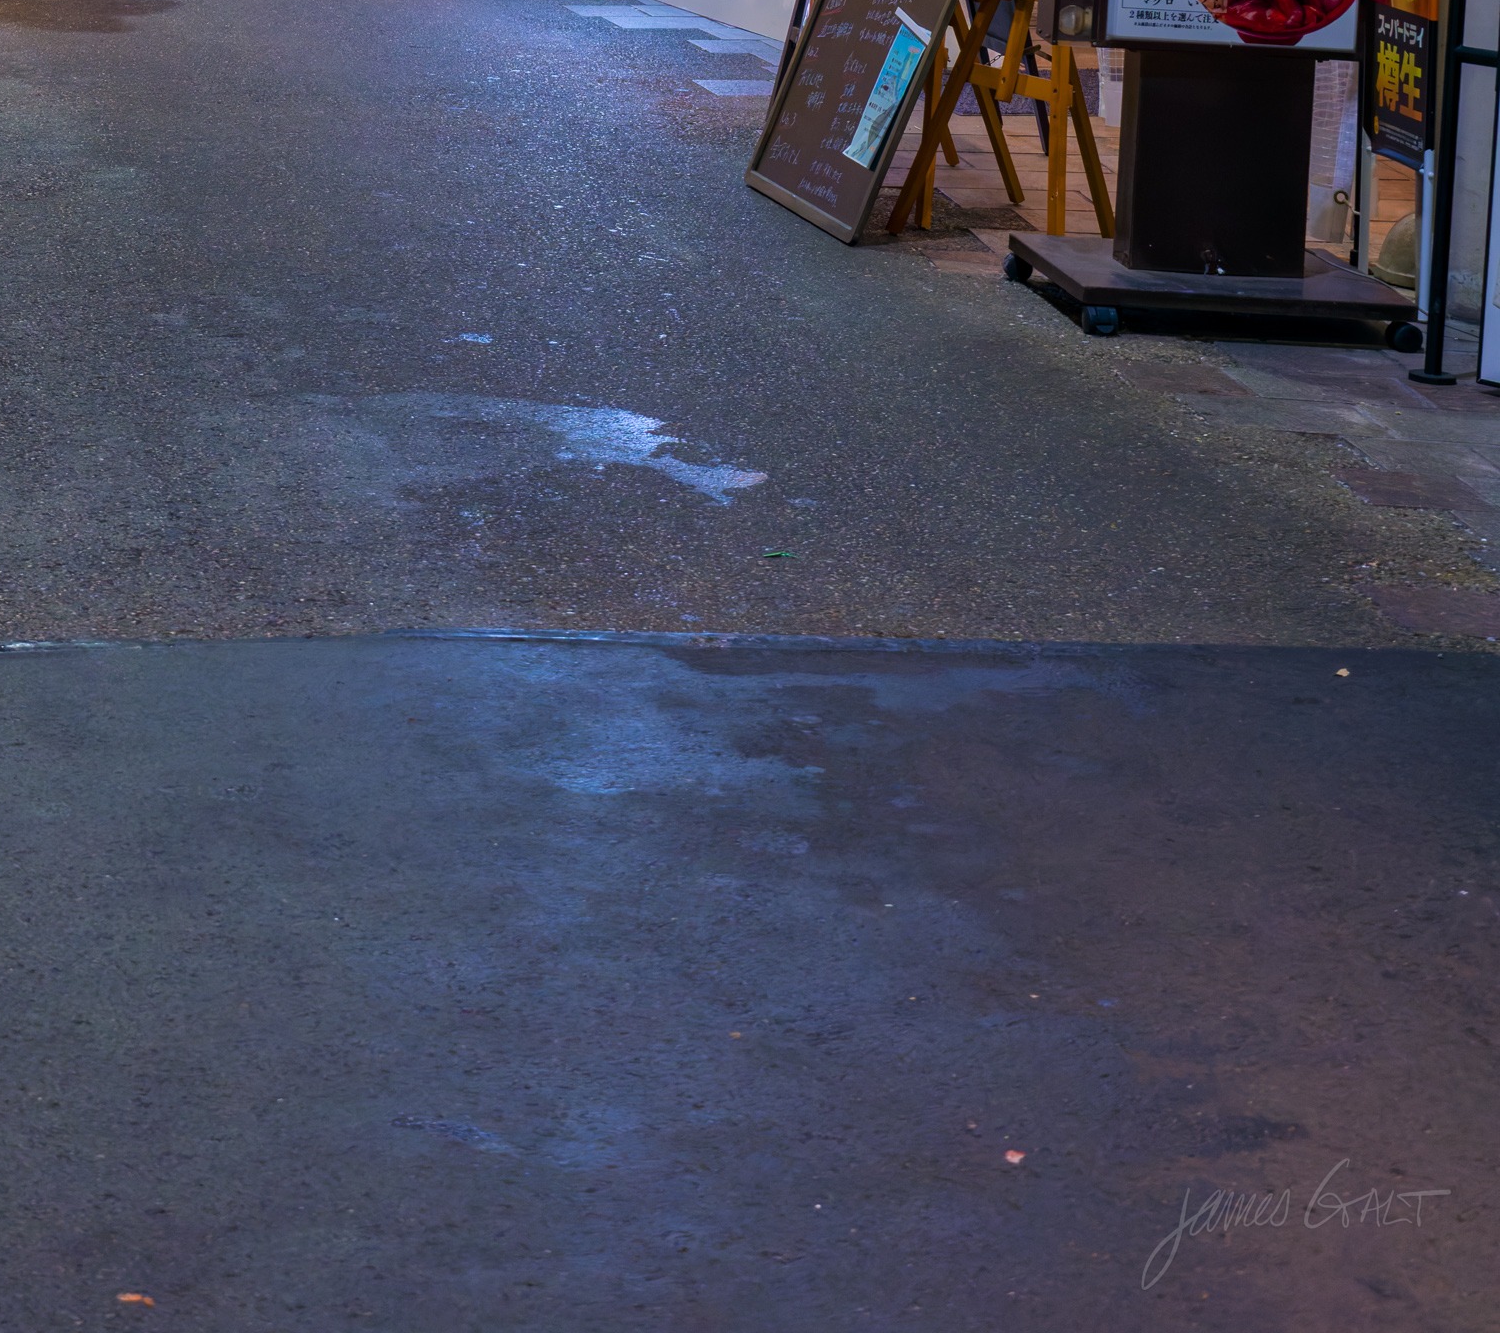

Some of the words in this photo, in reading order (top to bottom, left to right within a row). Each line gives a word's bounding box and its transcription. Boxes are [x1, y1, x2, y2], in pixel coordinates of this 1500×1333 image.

[1377, 13, 1425, 49] スーパードライ
[1376, 40, 1423, 122] 樽生
